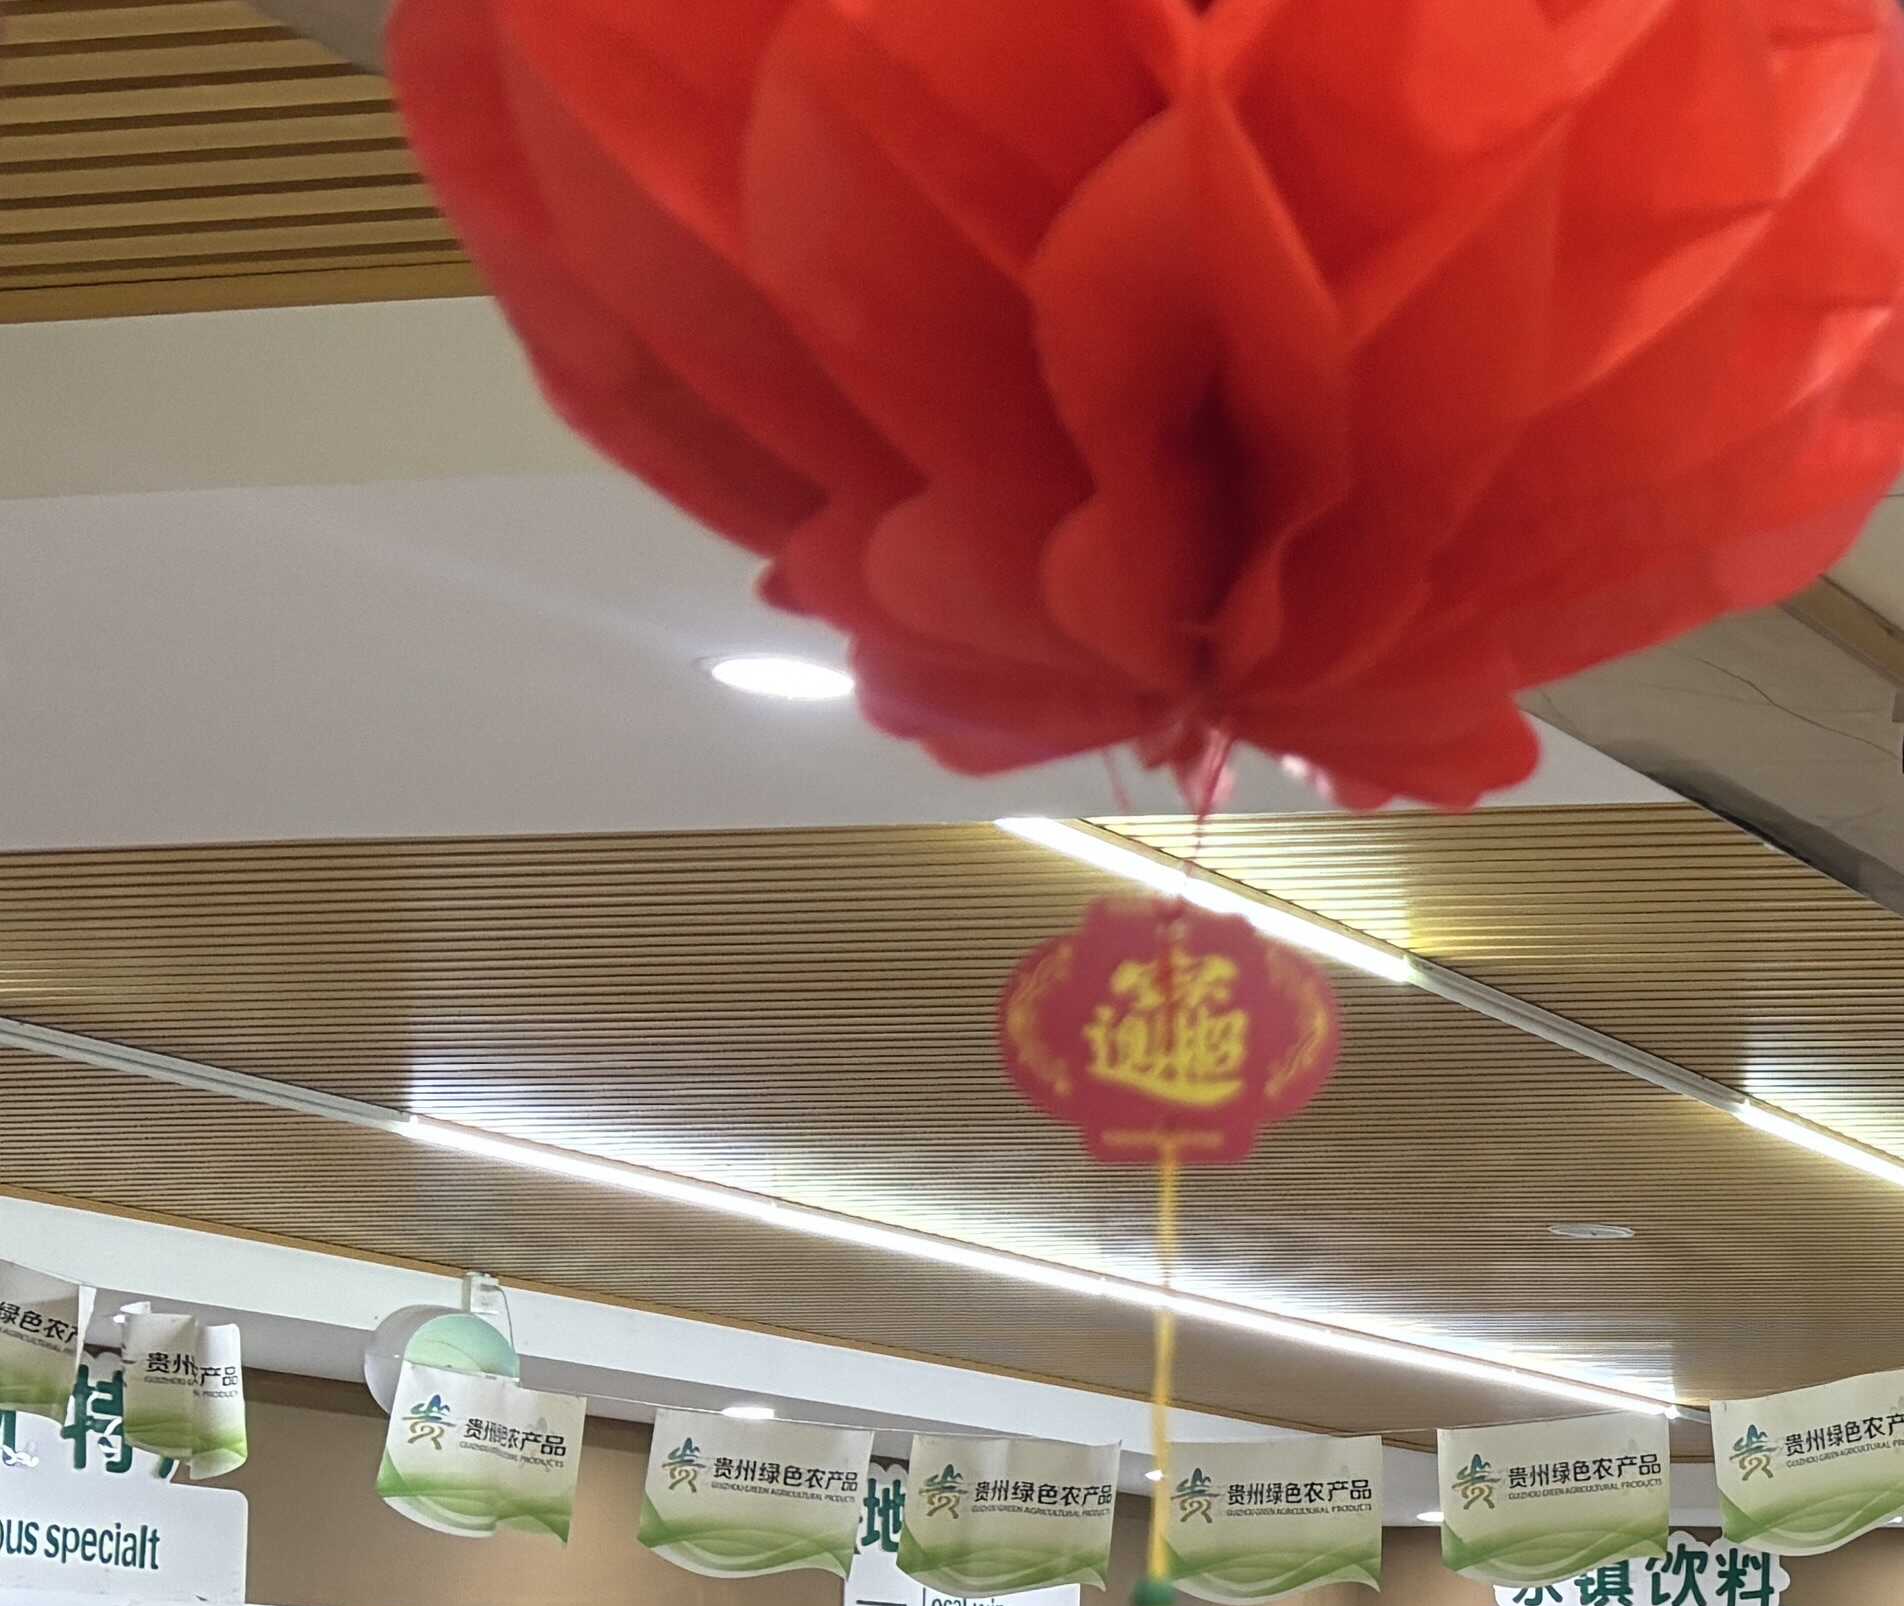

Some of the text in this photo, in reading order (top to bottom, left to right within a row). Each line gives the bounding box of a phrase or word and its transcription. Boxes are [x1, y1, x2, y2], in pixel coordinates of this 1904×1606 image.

[713, 1457, 858, 1491] 贵州绿色农产品
[1508, 1453, 1661, 1489] 贵州绿色农产品
[975, 1480, 1112, 1506] 贵州绿色农产品
[1227, 1479, 1372, 1505] 贵州绿色农产品
[44, 1522, 160, 1570] specialt
